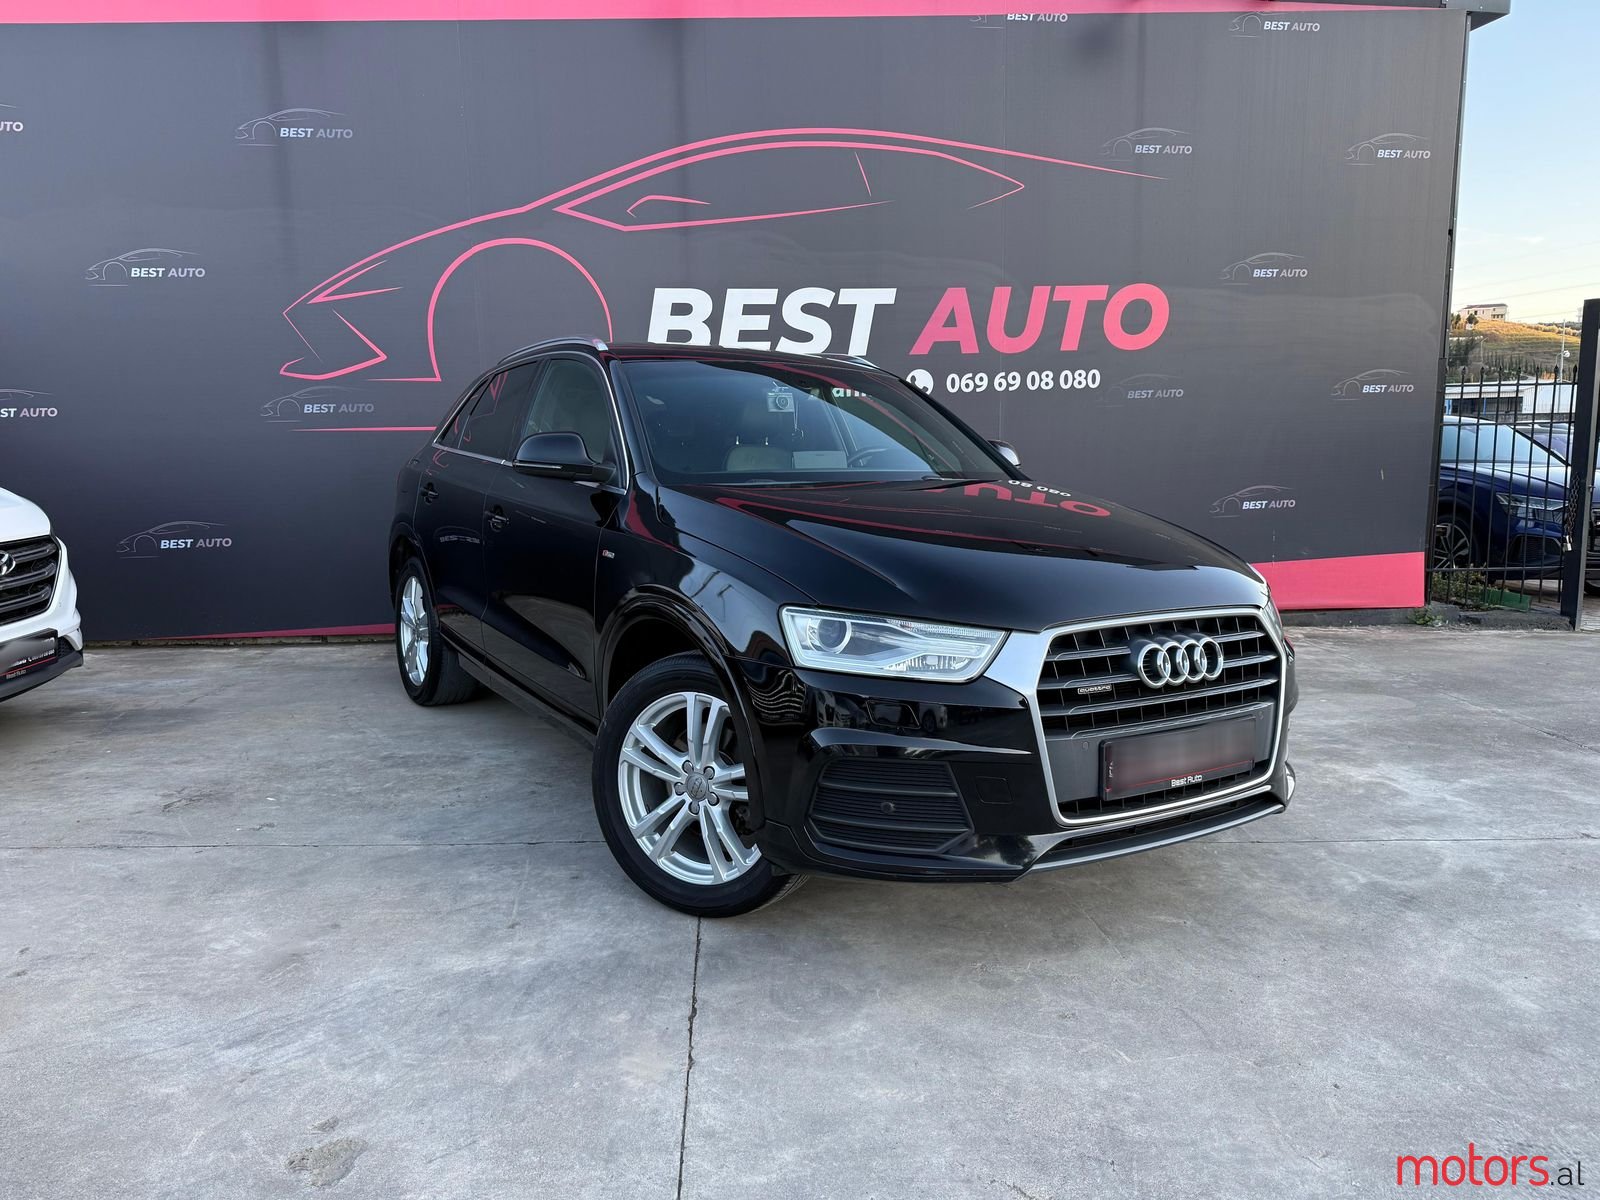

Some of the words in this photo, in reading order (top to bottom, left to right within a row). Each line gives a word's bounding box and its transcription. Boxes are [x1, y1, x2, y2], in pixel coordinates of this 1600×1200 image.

[1006, 13, 1036, 21] BEST
[1036, 13, 1069, 22] AUTO
[1263, 21, 1291, 31] BEST
[1291, 22, 1321, 32] AUTO
[0, 121, 24, 132] TO
[279, 127, 315, 138] BEST
[315, 128, 354, 139] AUTO
[1134, 144, 1162, 154] BEST
[1162, 144, 1193, 155] AUTO
[1376, 149, 1404, 159] BEST
[1403, 149, 1432, 159] AUTO
[130, 267, 166, 278] BEST
[167, 267, 206, 278] AUTO
[1252, 268, 1280, 278] BEST
[1279, 268, 1308, 278] AUTO
[647, 287, 897, 355] BEST
[909, 283, 1170, 355] AUTO
[945, 372, 989, 393] 069
[993, 371, 1022, 392] 69
[1026, 370, 1056, 391] 08
[1059, 368, 1101, 390] 080
[1127, 389, 1155, 399] BEST
[1154, 388, 1184, 398] AUTO
[1362, 384, 1388, 393] BEST
[1387, 384, 1415, 393] AUTO
[0, 407, 18, 418] ST
[19, 407, 58, 417] AUTO
[303, 403, 337, 414] BEST
[338, 402, 375, 413] AUTO
[1242, 500, 1269, 510] BEST
[1268, 499, 1296, 509] AUTO
[160, 537, 194, 549] BEST
[195, 537, 233, 548] AUTO
[1079, 685, 1111, 693] quattro
[1171, 777, 1186, 787] Best
